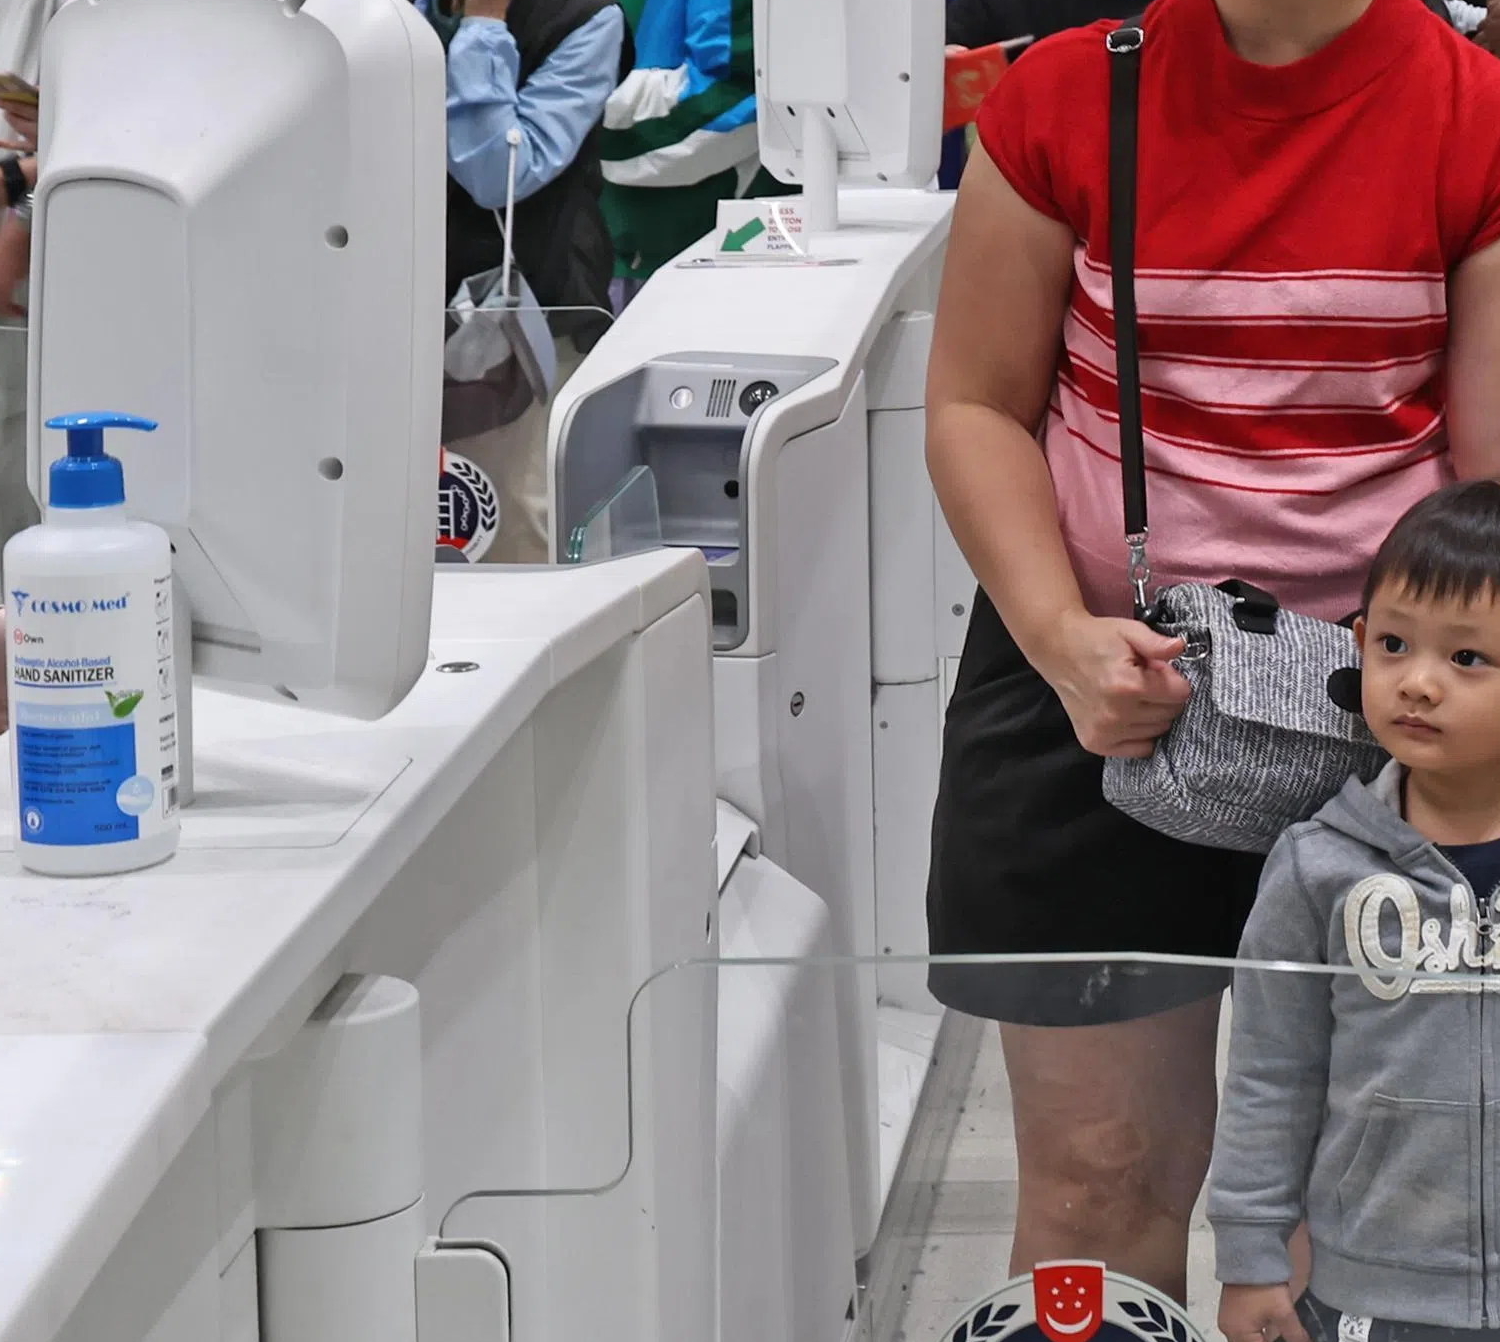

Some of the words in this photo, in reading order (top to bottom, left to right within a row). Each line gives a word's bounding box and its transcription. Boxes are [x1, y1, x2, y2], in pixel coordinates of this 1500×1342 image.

[30, 600, 88, 614] COSMO
[90, 596, 127, 612] Med
[14, 666, 41, 682] HAND
[43, 667, 115, 683] SANITIZER
